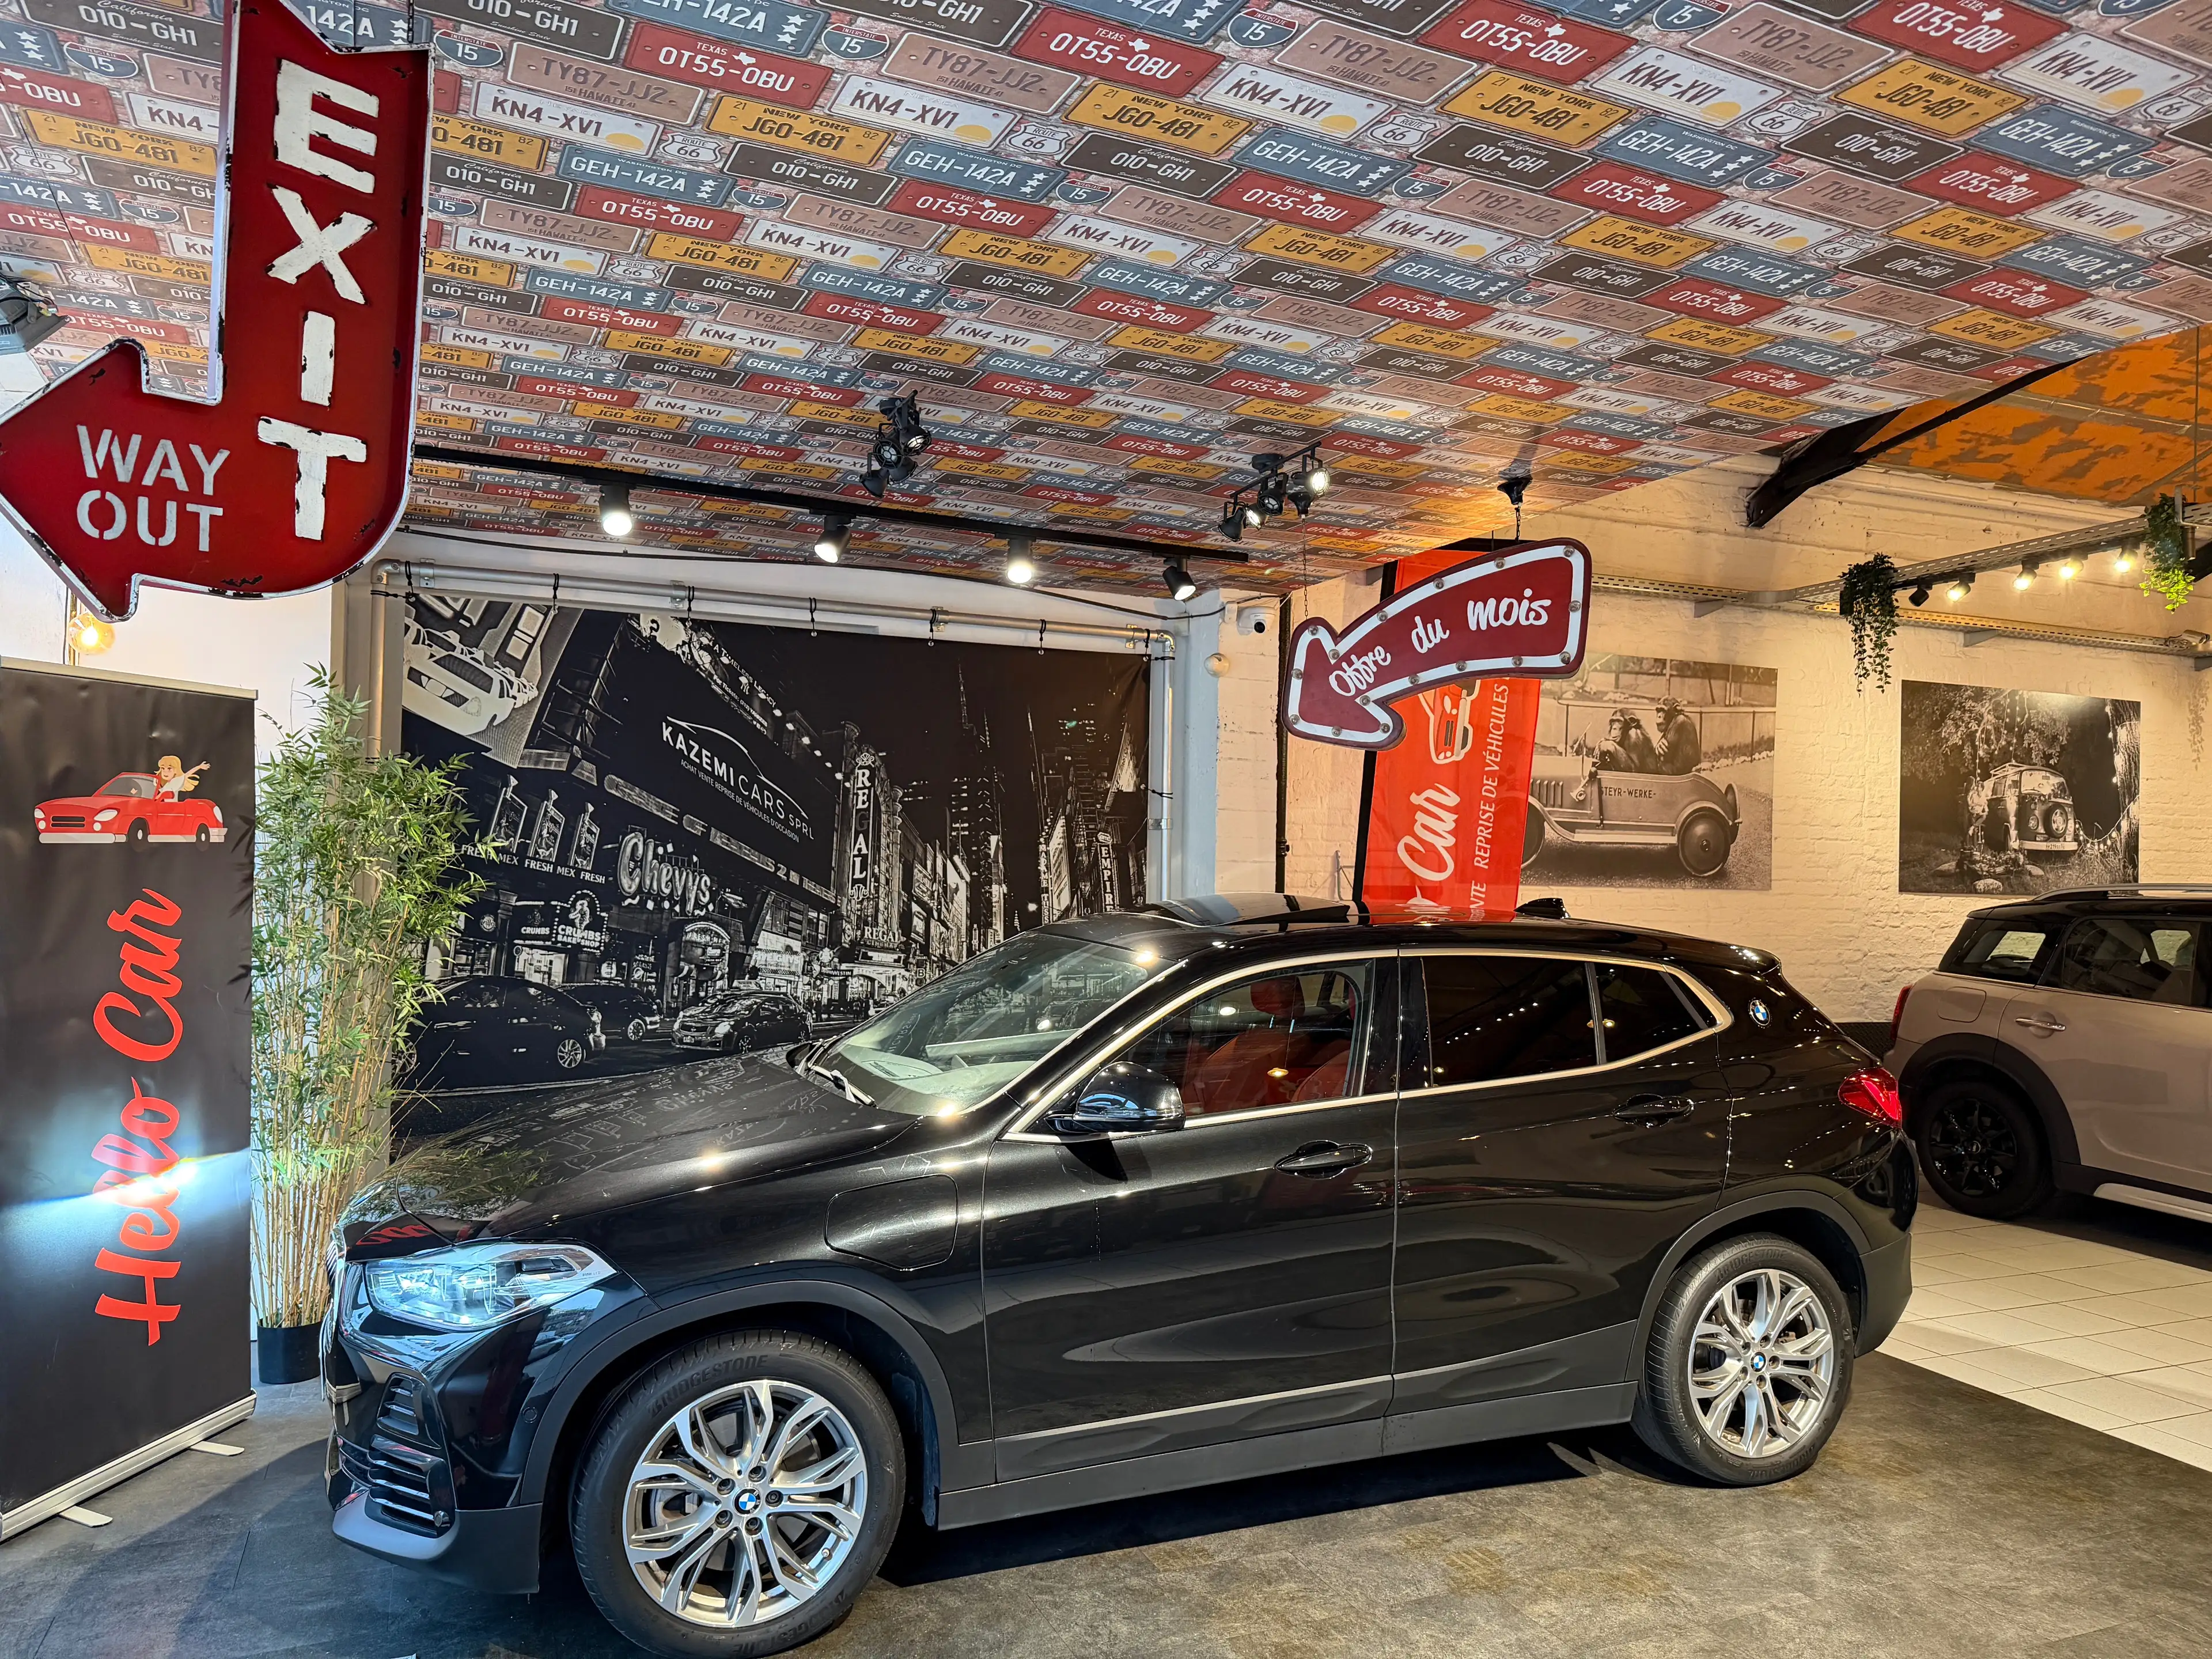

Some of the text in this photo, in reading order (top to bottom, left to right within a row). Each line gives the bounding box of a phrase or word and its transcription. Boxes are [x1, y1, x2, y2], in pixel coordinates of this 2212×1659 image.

[1240, 22, 1273, 41] 15
[1512, 13, 1547, 27] TEXAS
[838, 36, 866, 54] 15
[1093, 28, 1127, 41] TEXAS
[456, 43, 479, 61] 15
[695, 41, 728, 55] TEXAS
[88, 54, 115, 72] 15
[1103, 89, 1240, 128] 21 NEW YORK 82
[1517, 84, 1597, 109] NEW YORK
[763, 108, 852, 132] NEW YORK
[1395, 120, 1425, 131] ROUTE
[1755, 118, 1789, 131] 66
[680, 139, 707, 149] ROUTE
[1020, 139, 1048, 151] 66
[1029, 130, 1058, 139] ROUTE
[1378, 130, 1410, 143] 66
[1993, 117, 2105, 158] GEH-142A
[676, 148, 702, 159] 66
[1249, 139, 1365, 179] GEH-142A
[1613, 128, 1727, 169] GEH-142A
[29, 158, 55, 171] 66
[569, 156, 688, 192] GEH-142A
[902, 149, 1020, 186] GEH-142A
[1390, 262, 1487, 290] GEH-142A
[257, 59, 378, 540] EXIT
[510, 361, 595, 380] GEH-142A
[77, 424, 230, 496] WAY
[77, 490, 224, 552] OUT
[1411, 616, 1449, 653] du
[1467, 588, 1551, 631] mois
[1483, 683, 1509, 771] VÉHICULES
[681, 759, 697, 774] ACHAT
[698, 771, 714, 786] VENTE
[715, 781, 735, 800] REPRISE
[736, 796, 743, 804] DE
[1482, 775, 1498, 798] DE
[738, 775, 785, 819] CARS
[789, 814, 814, 840] SPRL
[853, 769, 872, 878] REGAL
[1397, 783, 1460, 881] Car
[1474, 800, 1495, 869] REPRISE
[498, 853, 519, 865] MEX
[524, 859, 554, 873] FRESH
[556, 866, 575, 878] MEX
[580, 871, 605, 884] FRESH
[618, 832, 711, 916] Chevys
[521, 926, 550, 934] CRUMBS
[558, 924, 601, 941] CRUMBS
[91, 888, 183, 1346] Hello Car
[647, 1355, 768, 1418] BRIDGESTONE
